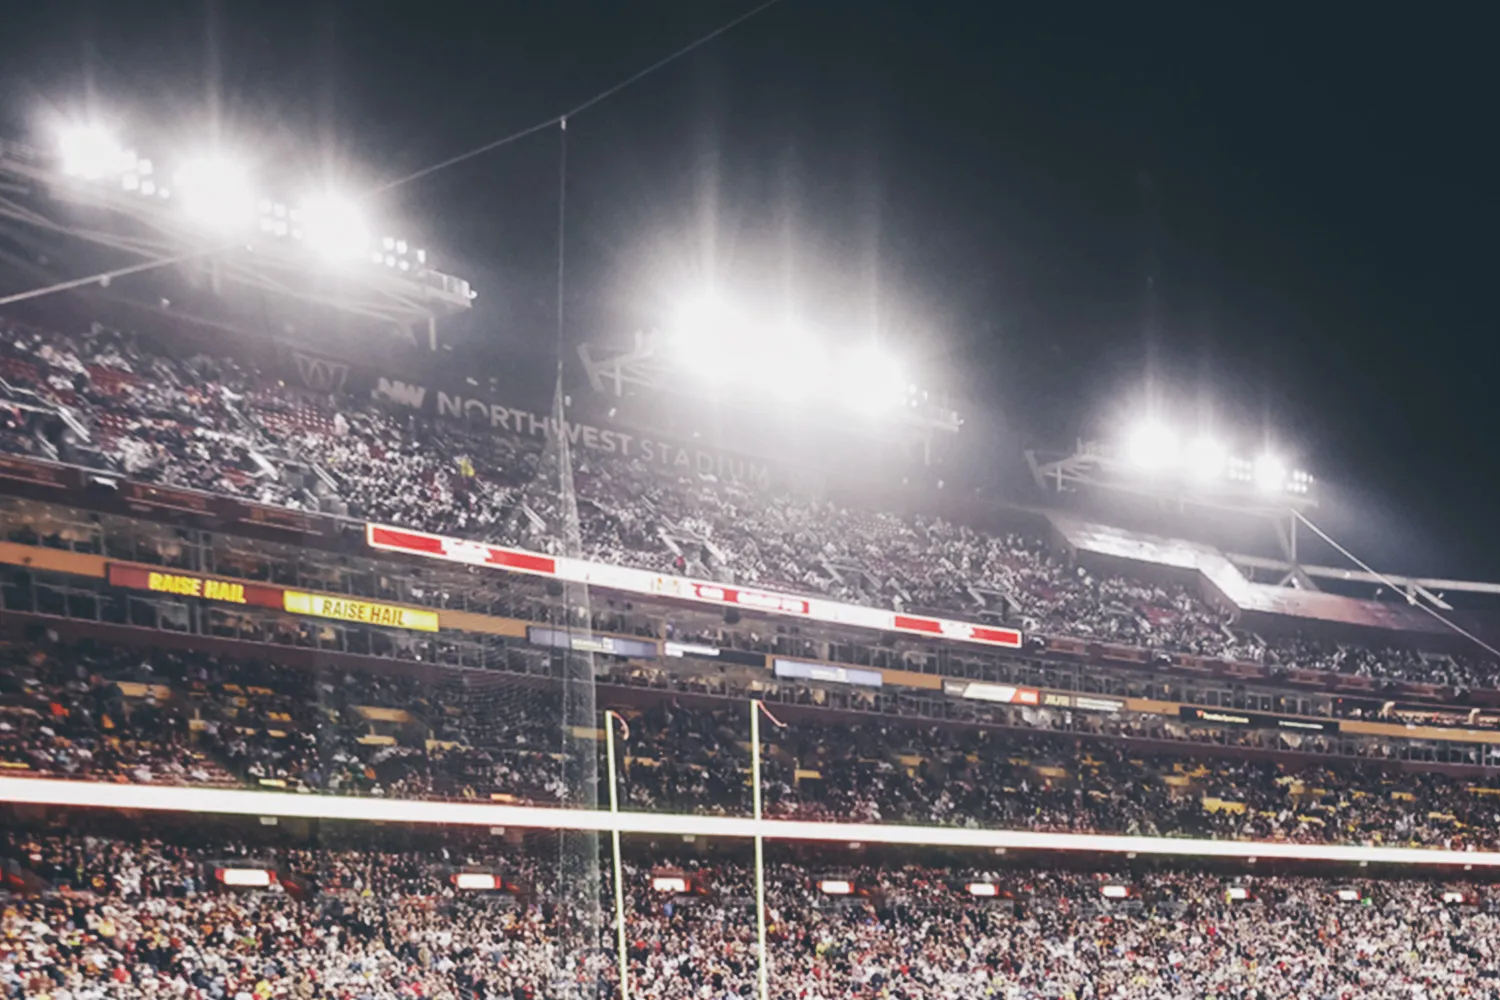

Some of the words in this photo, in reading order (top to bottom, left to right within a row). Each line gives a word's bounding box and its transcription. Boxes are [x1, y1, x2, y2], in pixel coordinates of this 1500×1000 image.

[438, 390, 633, 456] NORTHWEST
[149, 572, 201, 596] RAISE
[204, 579, 246, 603] HAIL
[322, 599, 365, 621] RAISE
[369, 606, 405, 626] HAIL
